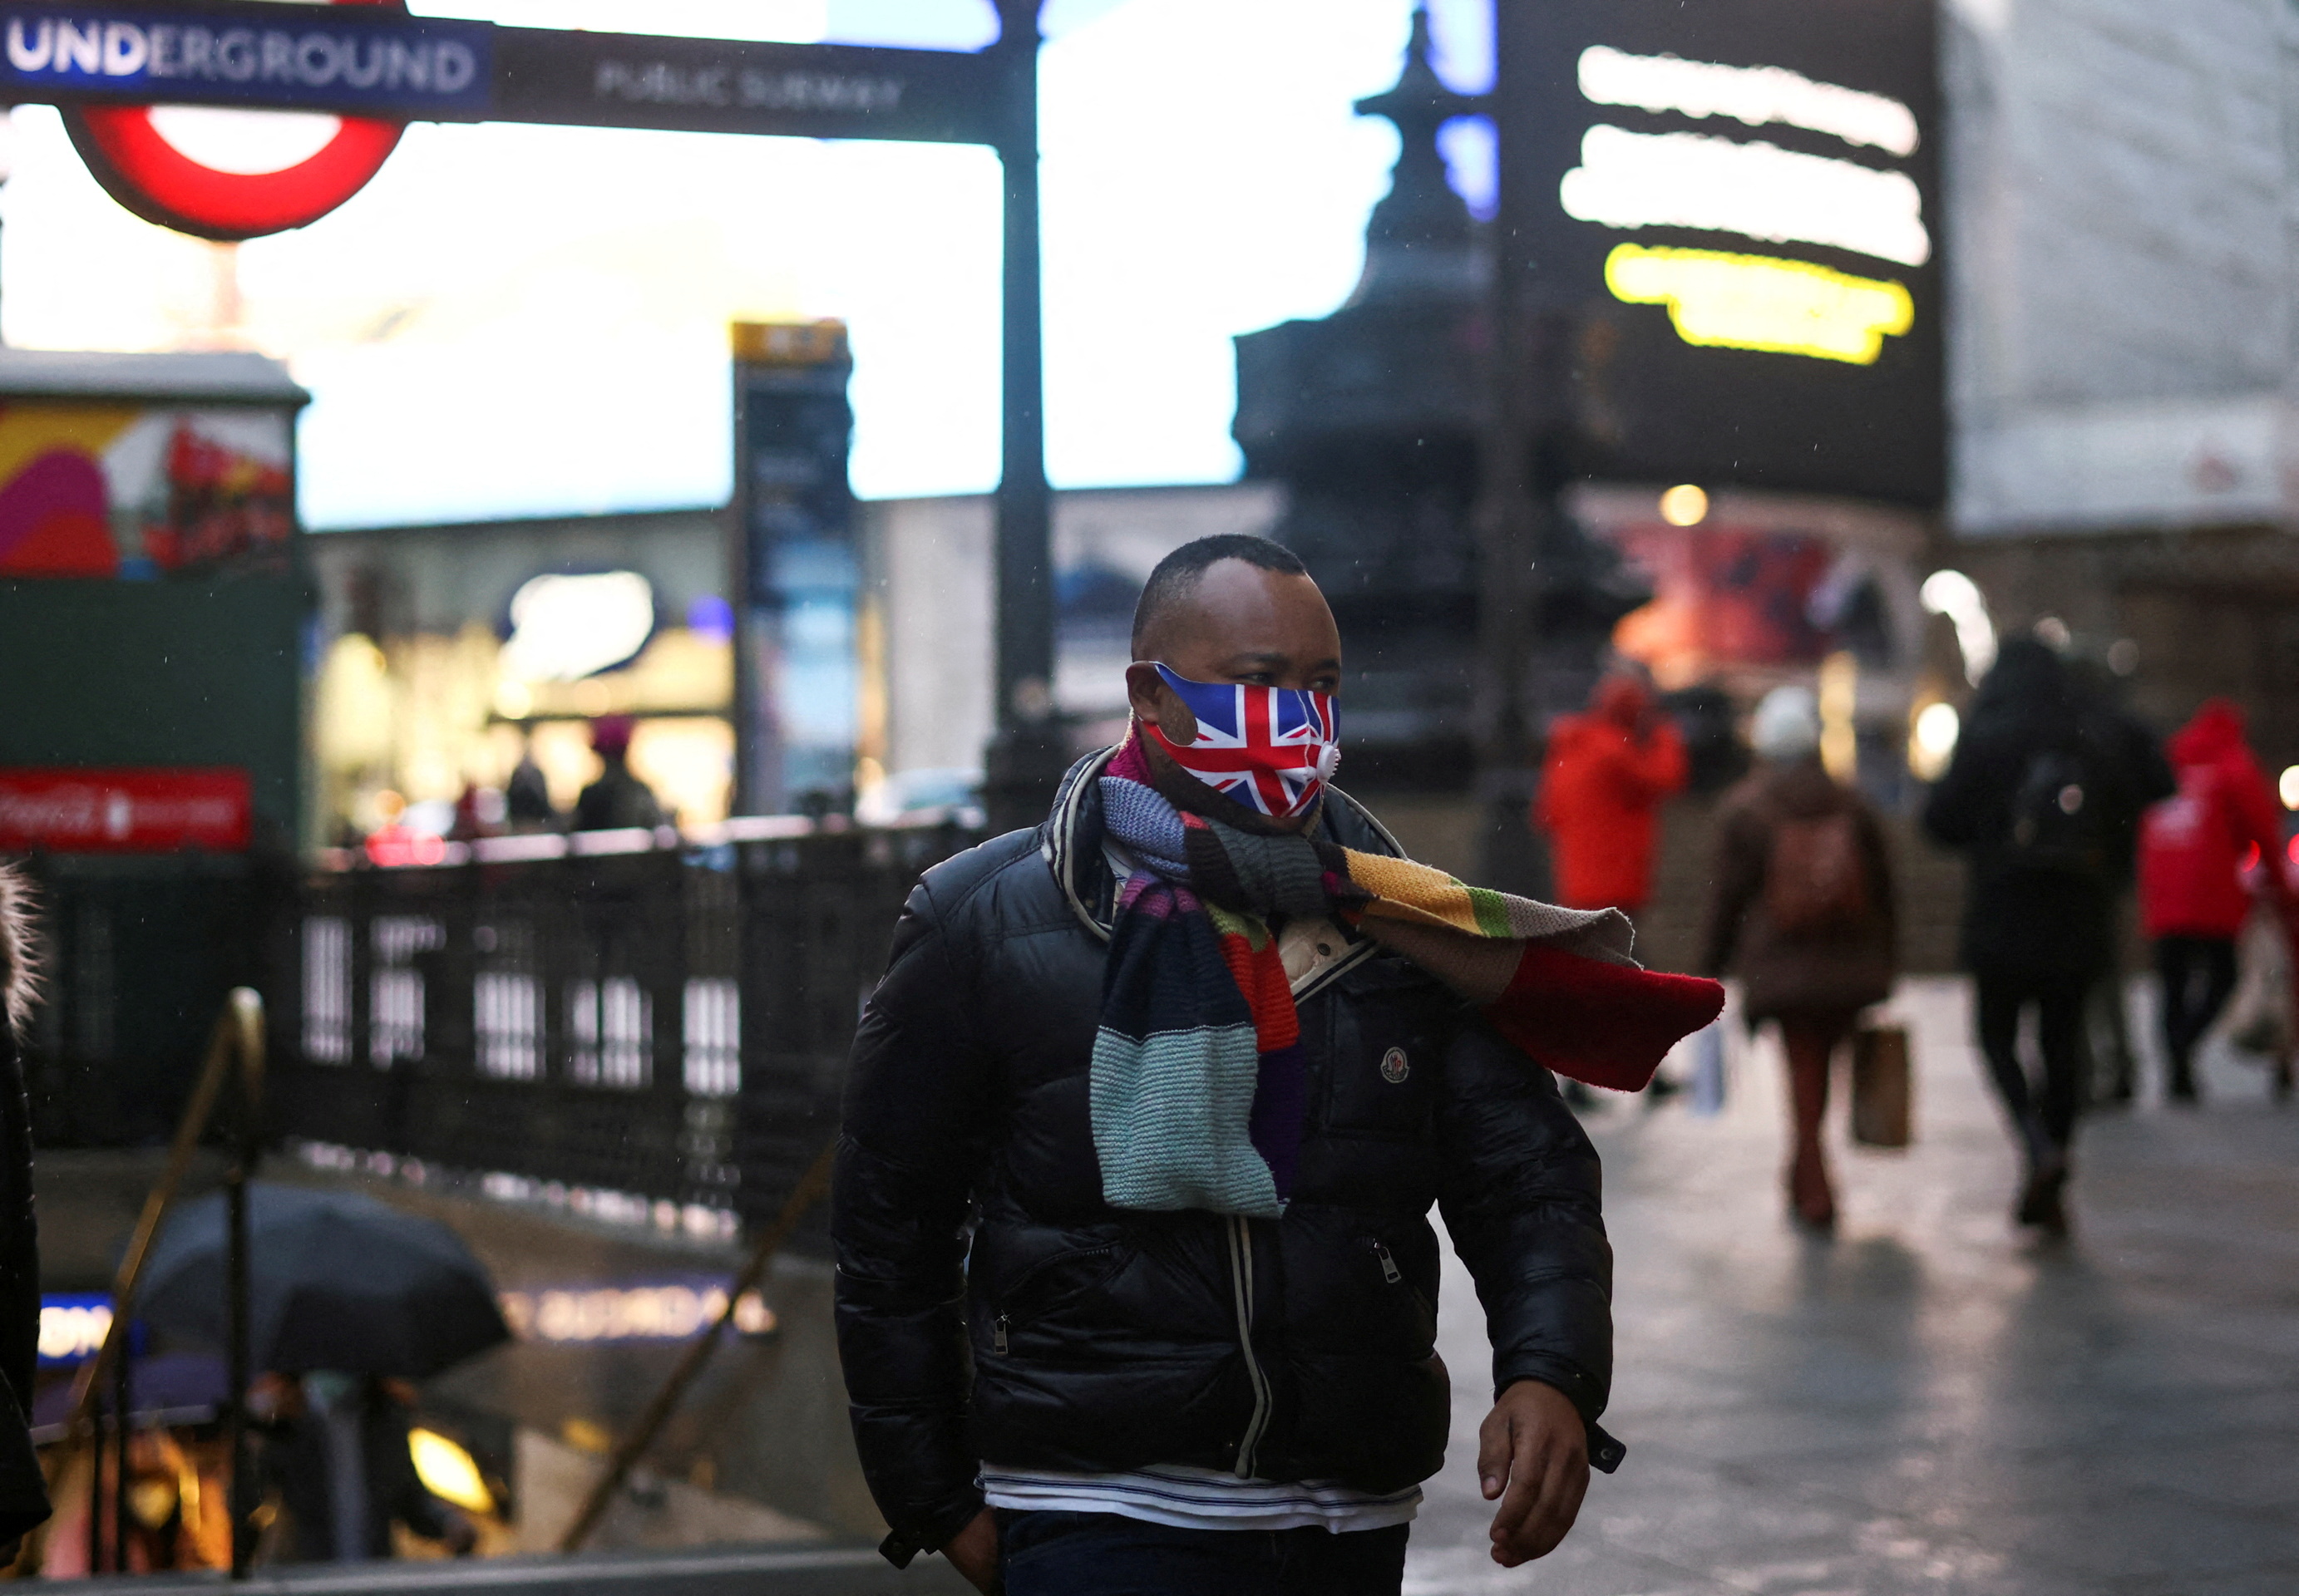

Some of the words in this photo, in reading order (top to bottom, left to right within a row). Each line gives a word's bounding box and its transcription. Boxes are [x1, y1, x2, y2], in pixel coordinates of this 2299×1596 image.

[7, 17, 476, 92] UNDERGROUND
[594, 61, 730, 106] PUBLIC
[740, 69, 902, 110] SUBWAY
